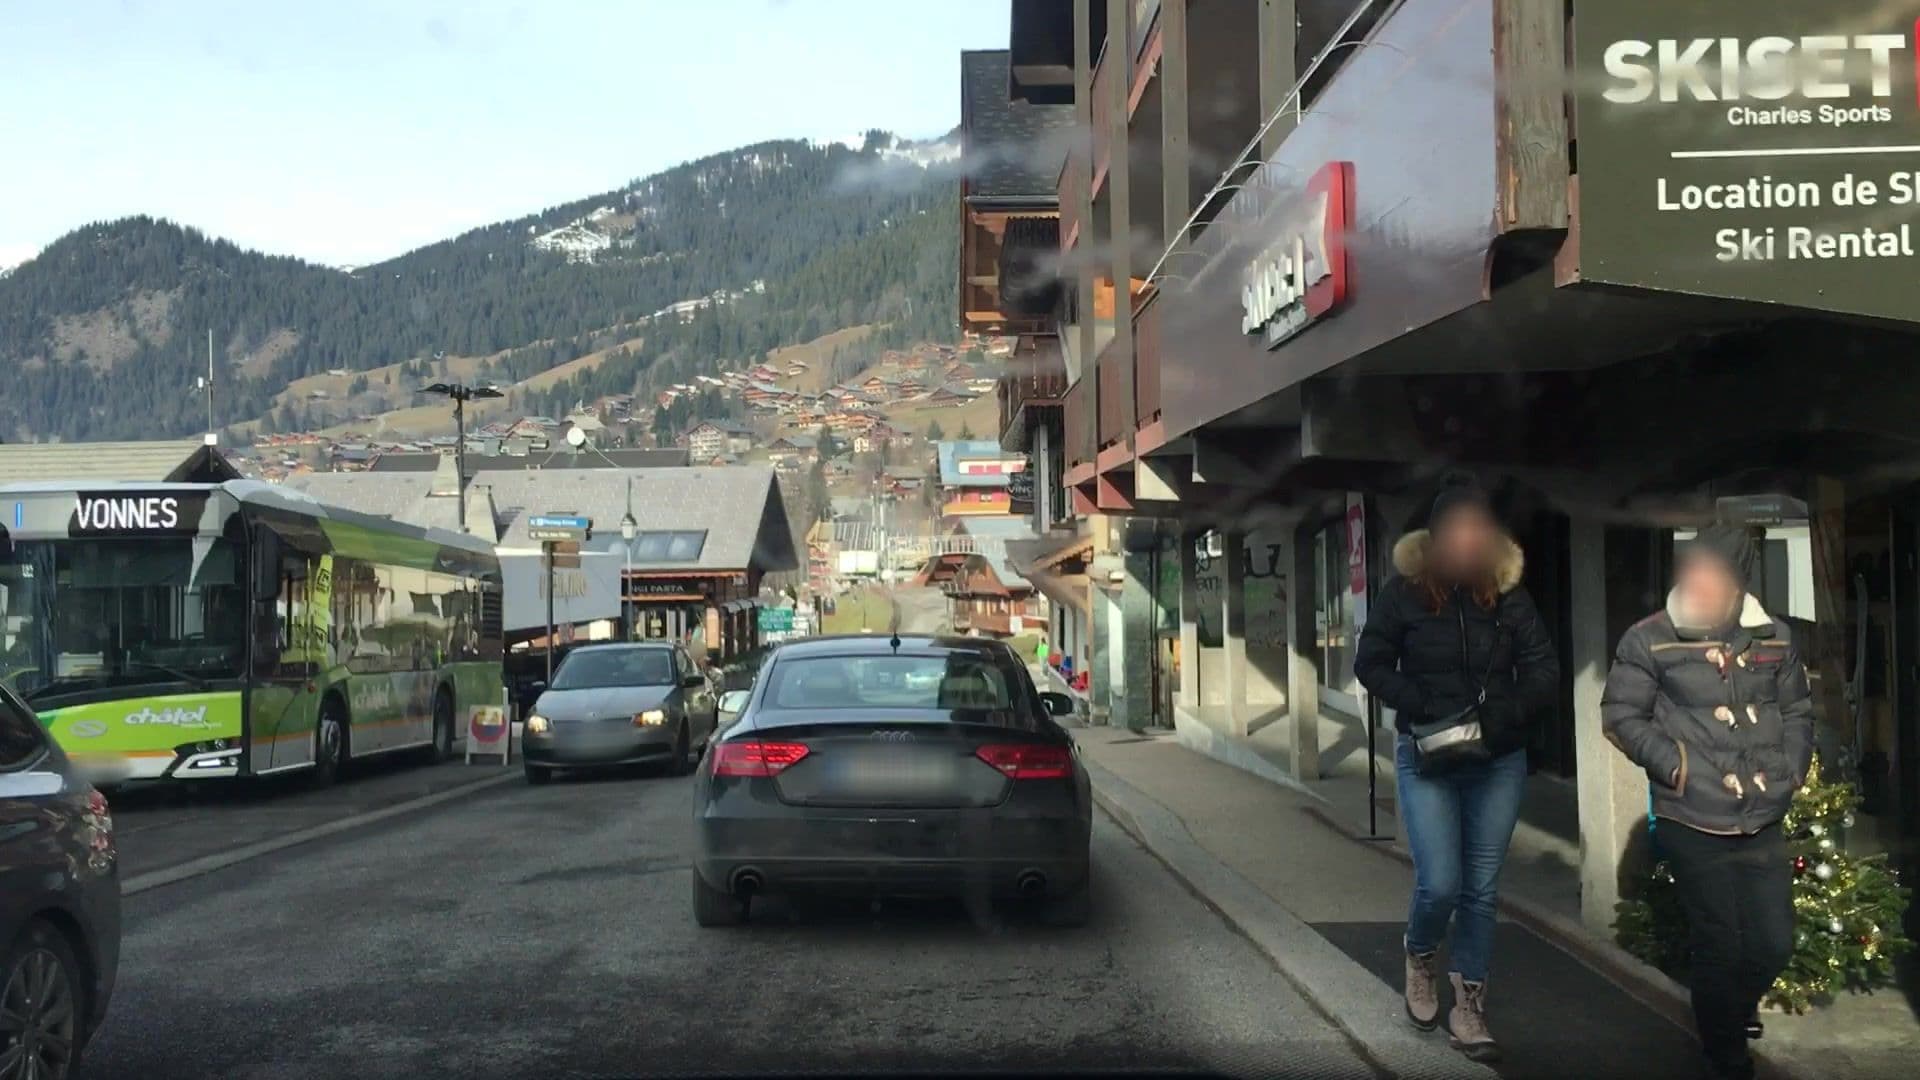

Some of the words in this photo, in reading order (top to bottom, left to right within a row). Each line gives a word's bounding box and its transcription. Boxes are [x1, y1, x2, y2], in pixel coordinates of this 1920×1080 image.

[1602, 34, 1906, 103] SKISET
[1727, 106, 1812, 125] Charles
[1819, 104, 1892, 127] Sports
[1657, 175, 1820, 211] Location
[1832, 173, 1878, 206] de
[1888, 171, 1920, 204] S
[1715, 227, 1775, 262] Ski
[1788, 223, 1914, 259] Rental
[75, 497, 178, 529] VONNES
